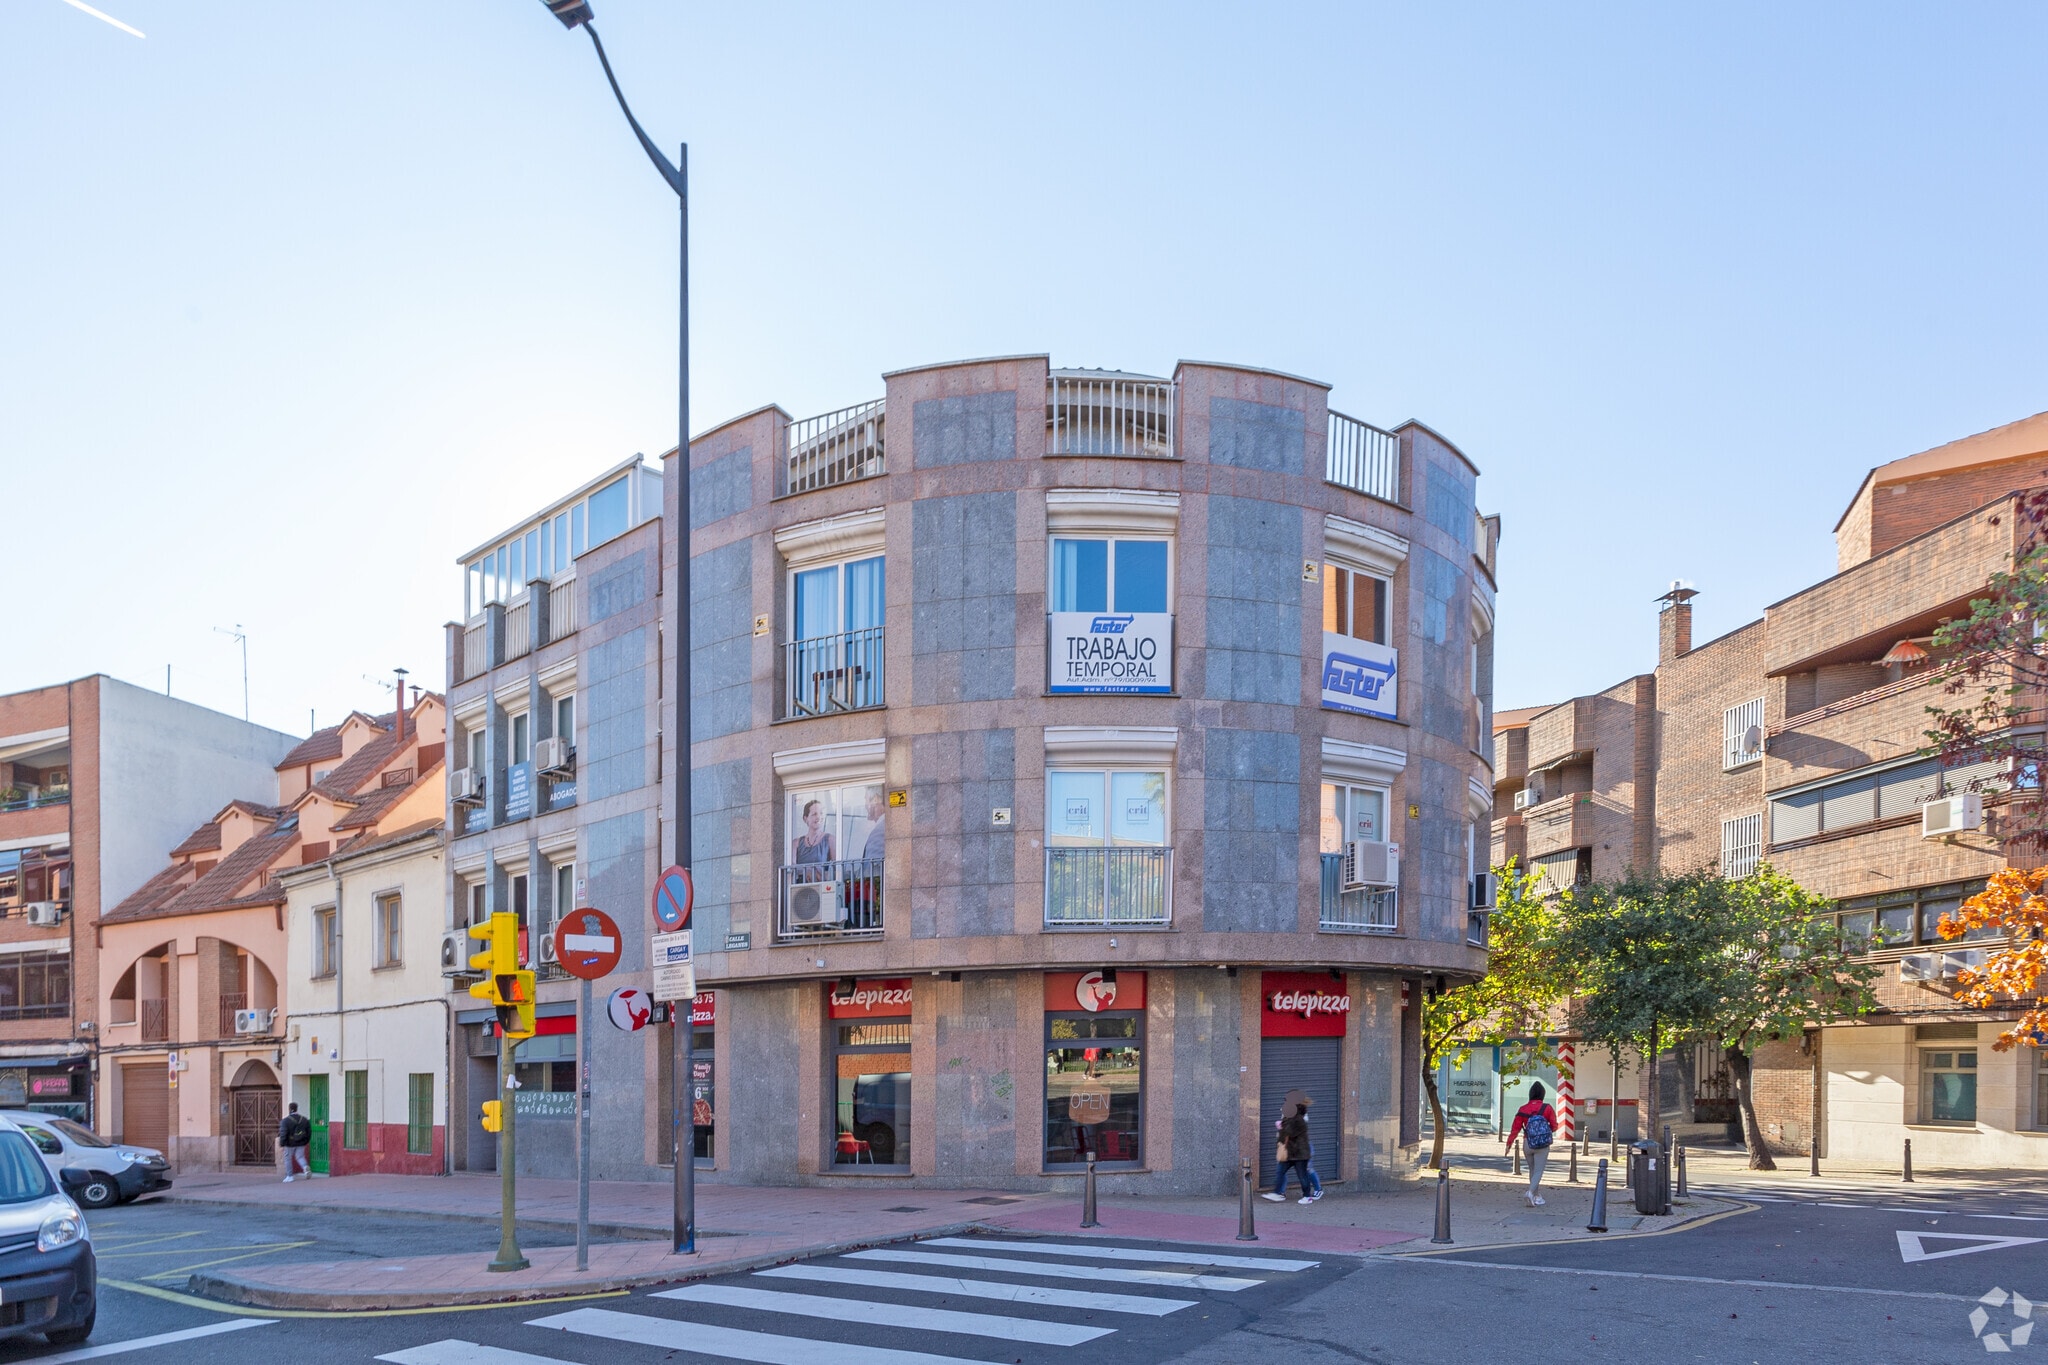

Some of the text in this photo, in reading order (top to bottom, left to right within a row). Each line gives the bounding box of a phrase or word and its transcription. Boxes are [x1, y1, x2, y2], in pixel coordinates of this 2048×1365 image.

[1066, 637, 1157, 660] TRABAJO
[1066, 661, 1157, 678] TEMPORAL
[1068, 804, 1088, 815] crit
[1128, 804, 1147, 815] crit
[1359, 819, 1372, 829] crit
[670, 946, 682, 954] CARGA
[668, 953, 688, 961] DESCARGA
[704, 993, 714, 1003] 75
[1273, 990, 1350, 1018] telepizza
[693, 1063, 711, 1074] Family
[693, 1070, 706, 1079] Days
[1071, 1092, 1111, 1110] OPEN
